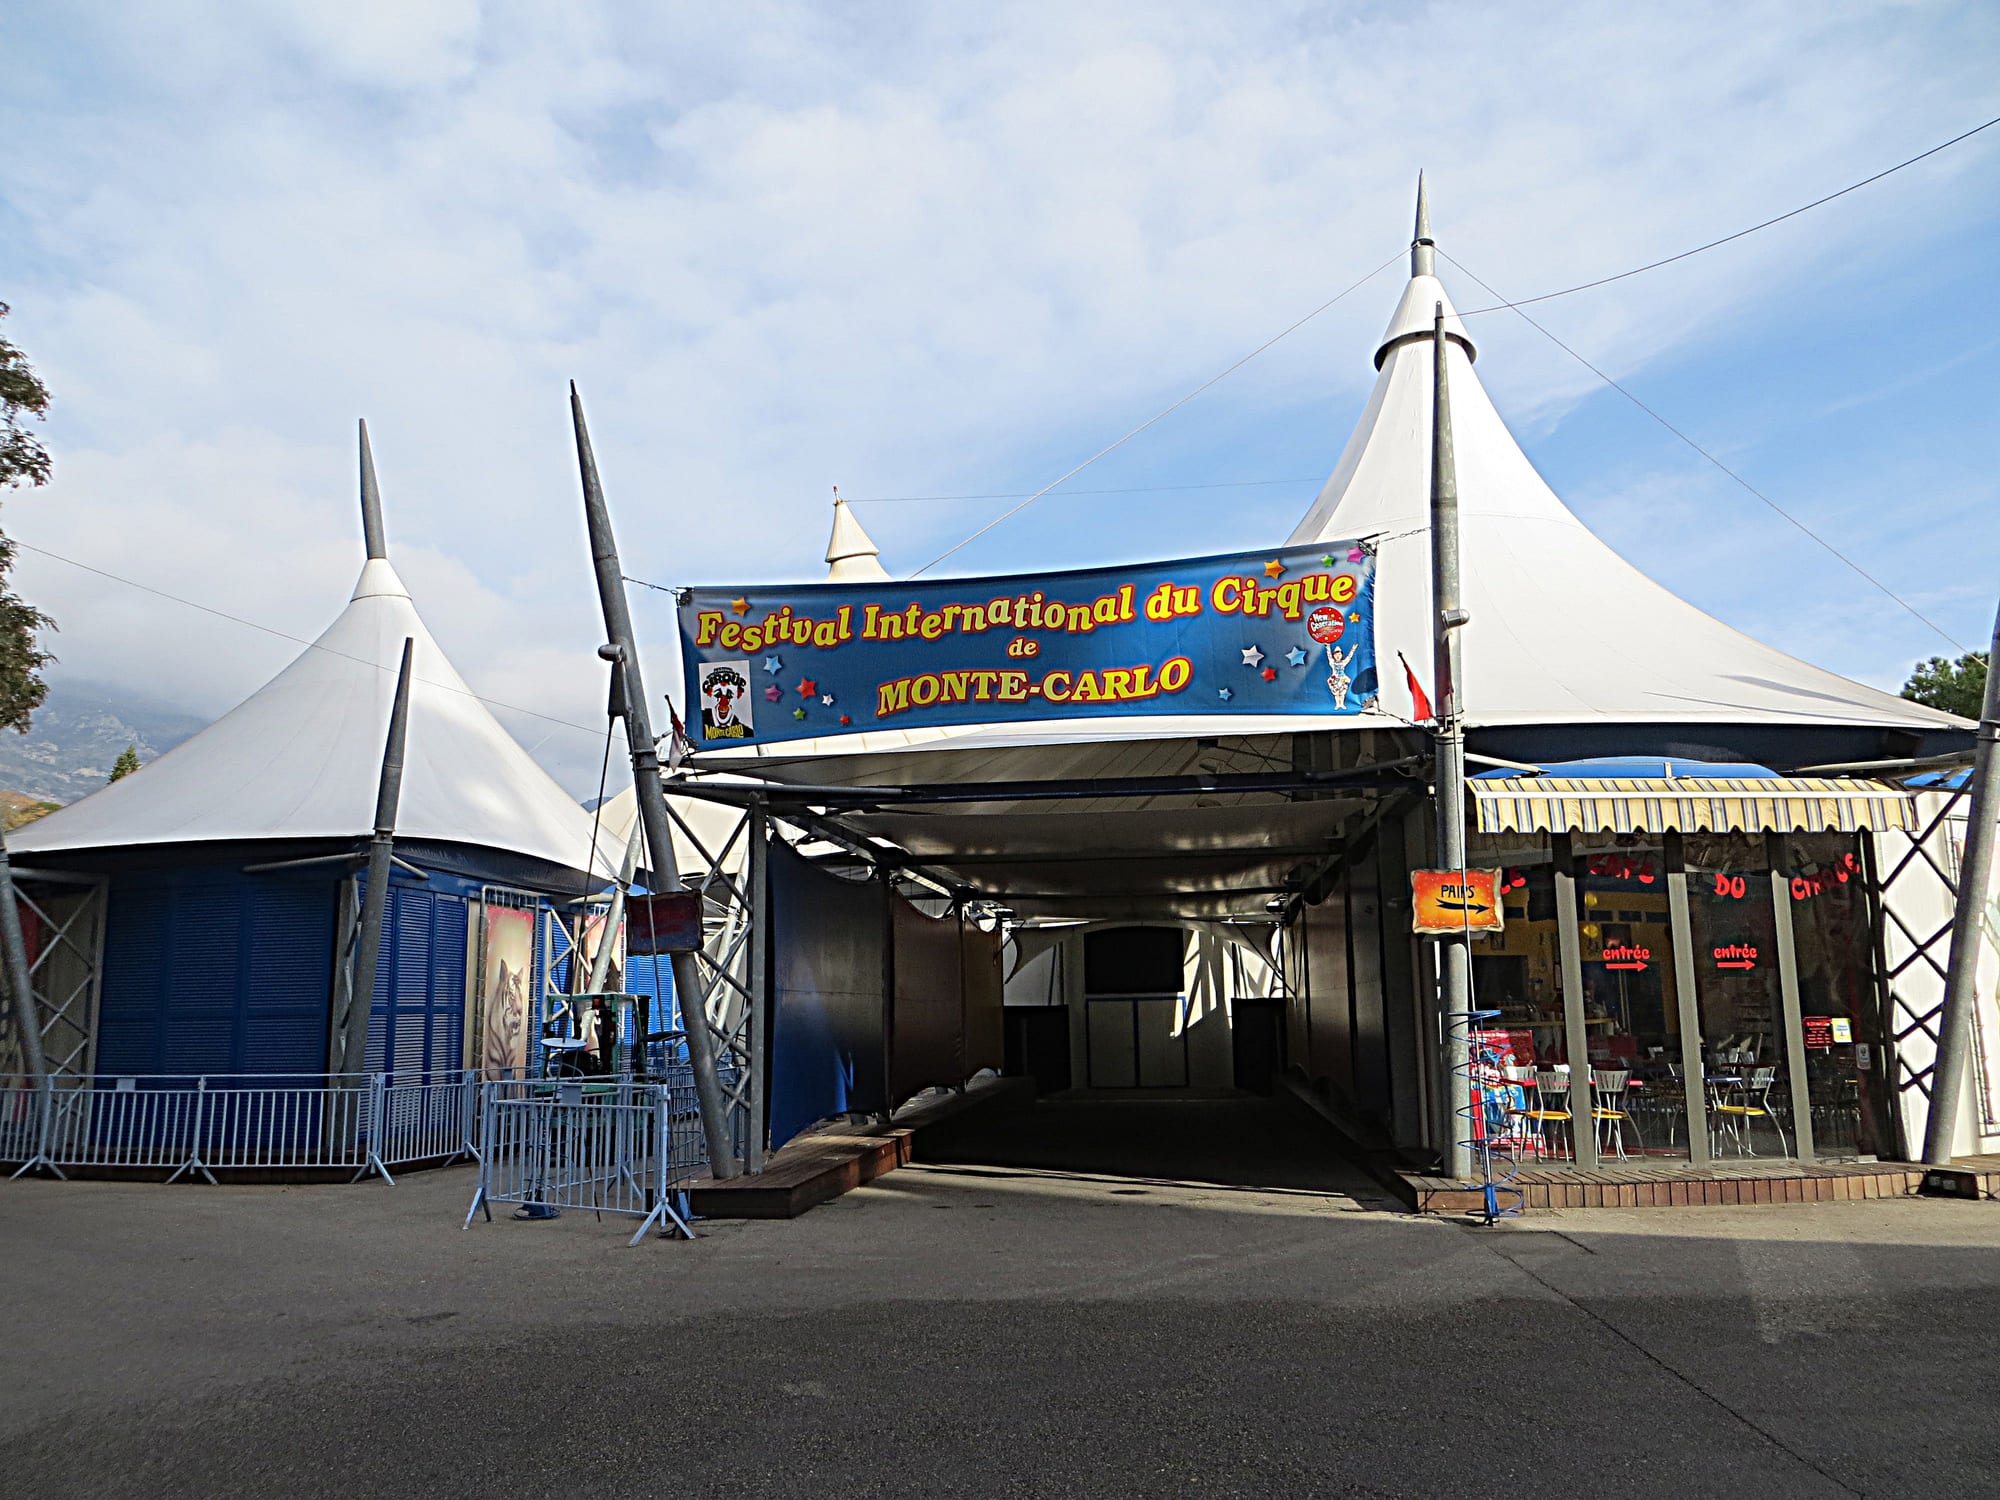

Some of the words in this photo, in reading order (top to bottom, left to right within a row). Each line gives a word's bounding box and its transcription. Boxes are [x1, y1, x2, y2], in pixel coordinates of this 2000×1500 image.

[695, 604, 855, 652] Festival
[862, 585, 1135, 640] International
[1146, 585, 1200, 619] du
[1212, 575, 1354, 619] Cirque
[1008, 638, 1038, 657] de
[877, 658, 1191, 715] MONTE-CARLO
[1713, 871, 1747, 899] DU
[1602, 944, 1651, 960] entrée
[1713, 943, 1758, 959] entrée
